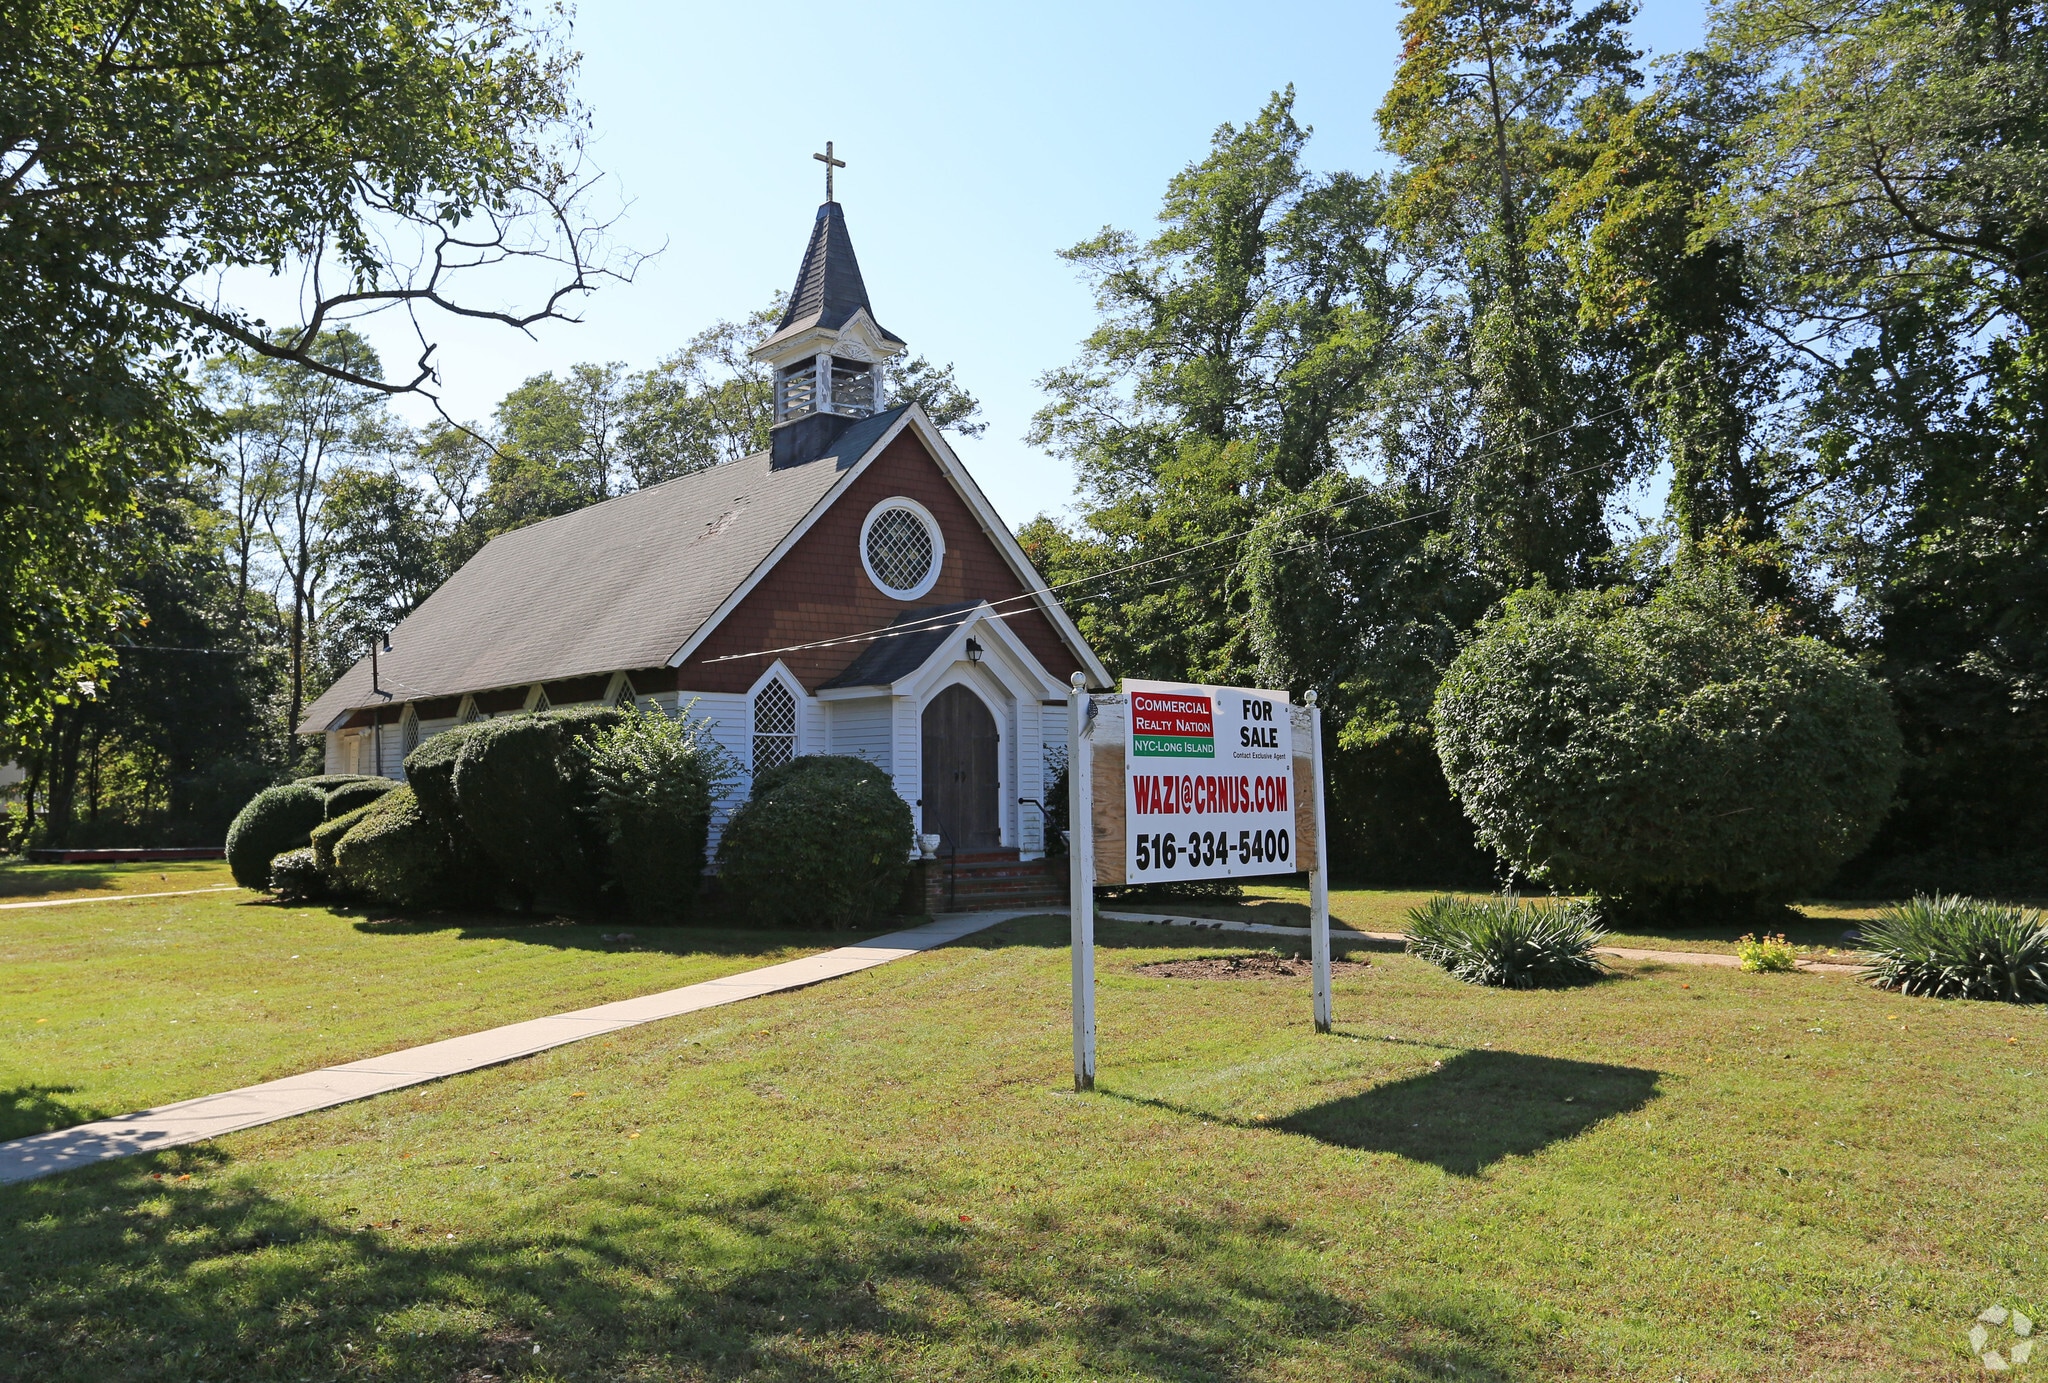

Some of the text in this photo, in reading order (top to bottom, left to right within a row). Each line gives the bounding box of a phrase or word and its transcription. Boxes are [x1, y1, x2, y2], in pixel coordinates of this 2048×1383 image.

[1135, 697, 1209, 714] COMMERCIAL
[1243, 699, 1272, 721] FOR
[1136, 717, 1210, 733] REALTY NATION
[1240, 726, 1278, 748] SALE
[1184, 741, 1214, 753] ISLAND
[1252, 752, 1272, 760] Exclusive
[1273, 753, 1286, 761] Agent
[1133, 775, 1288, 814] WAZI@CRNUS.COM
[1136, 829, 1289, 870] 516-334-5400
